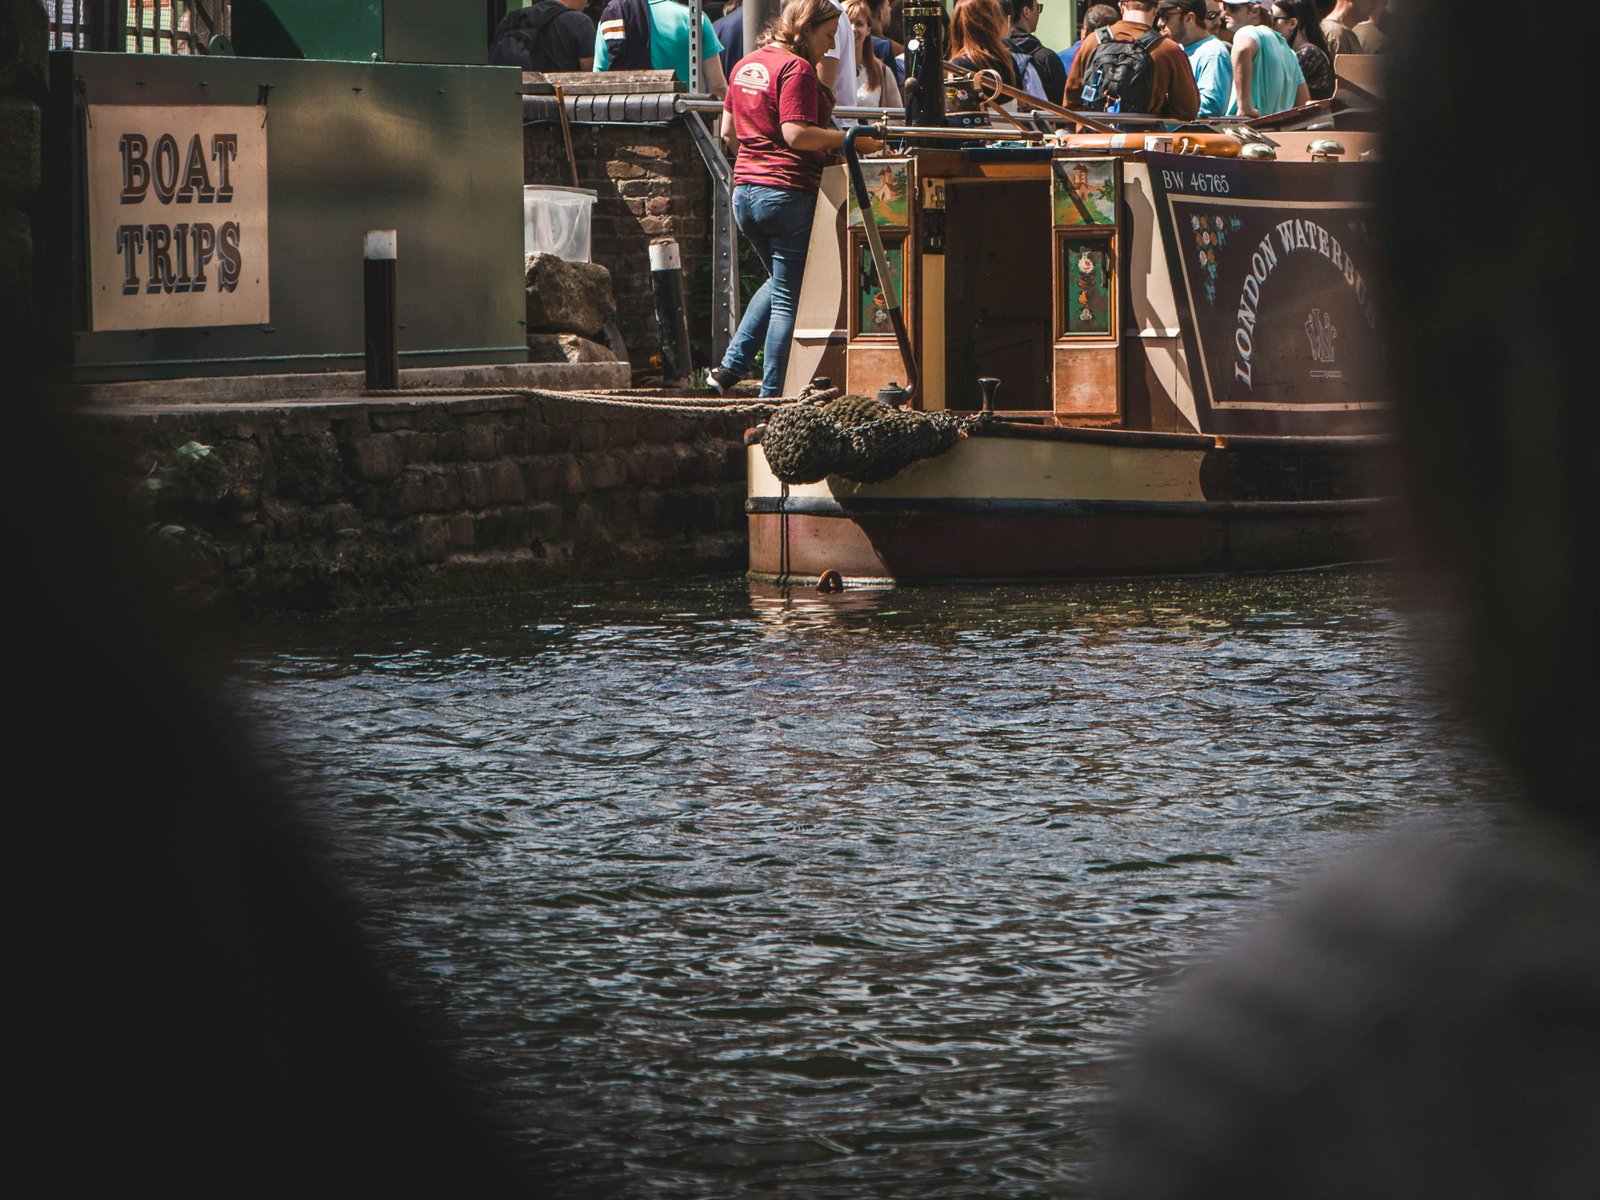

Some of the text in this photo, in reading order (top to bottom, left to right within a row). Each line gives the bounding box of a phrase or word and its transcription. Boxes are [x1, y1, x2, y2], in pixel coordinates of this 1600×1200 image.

[119, 133, 237, 204] BOAT
[1161, 169, 1229, 194] BW 46765
[117, 221, 242, 295] TRIPS
[1234, 232, 1278, 392] LONDON
